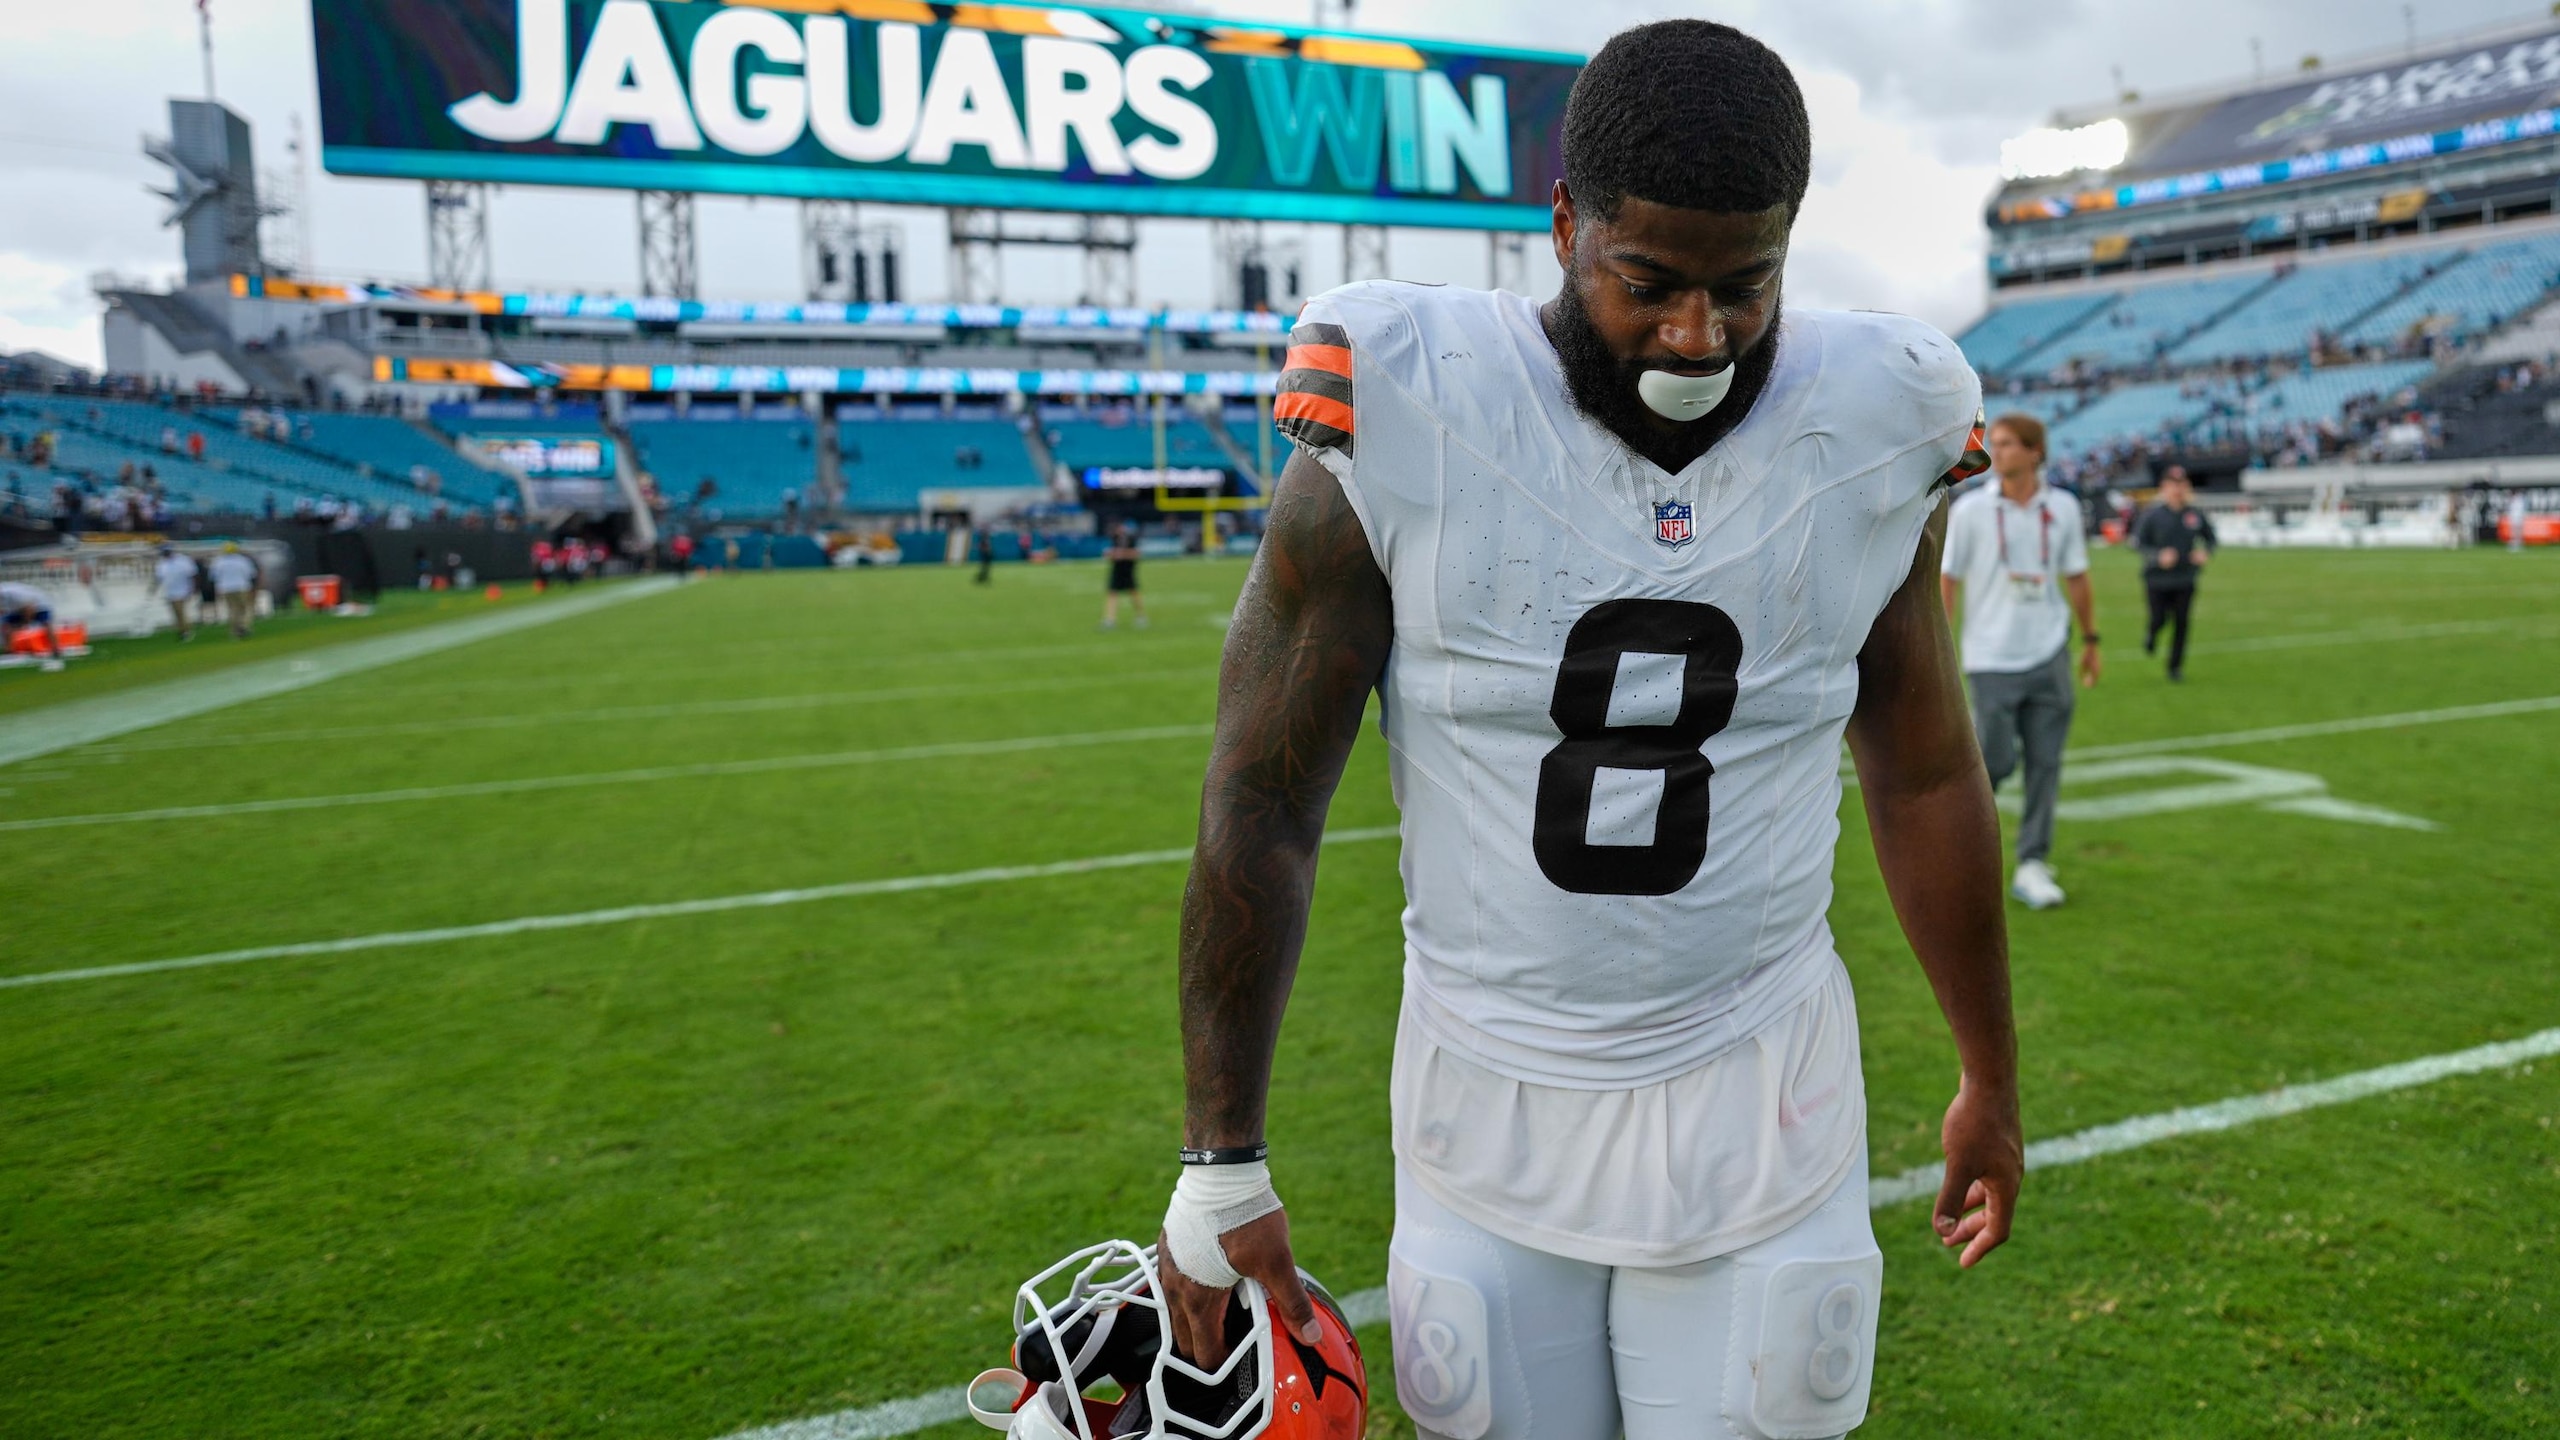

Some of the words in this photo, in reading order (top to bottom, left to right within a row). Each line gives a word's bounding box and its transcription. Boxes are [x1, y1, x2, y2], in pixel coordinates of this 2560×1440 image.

[446, 0, 1217, 179] JAGUARS
[1244, 56, 1511, 197] WIN
[1660, 520, 1689, 541] NFL
[1533, 598, 1744, 897] 8
